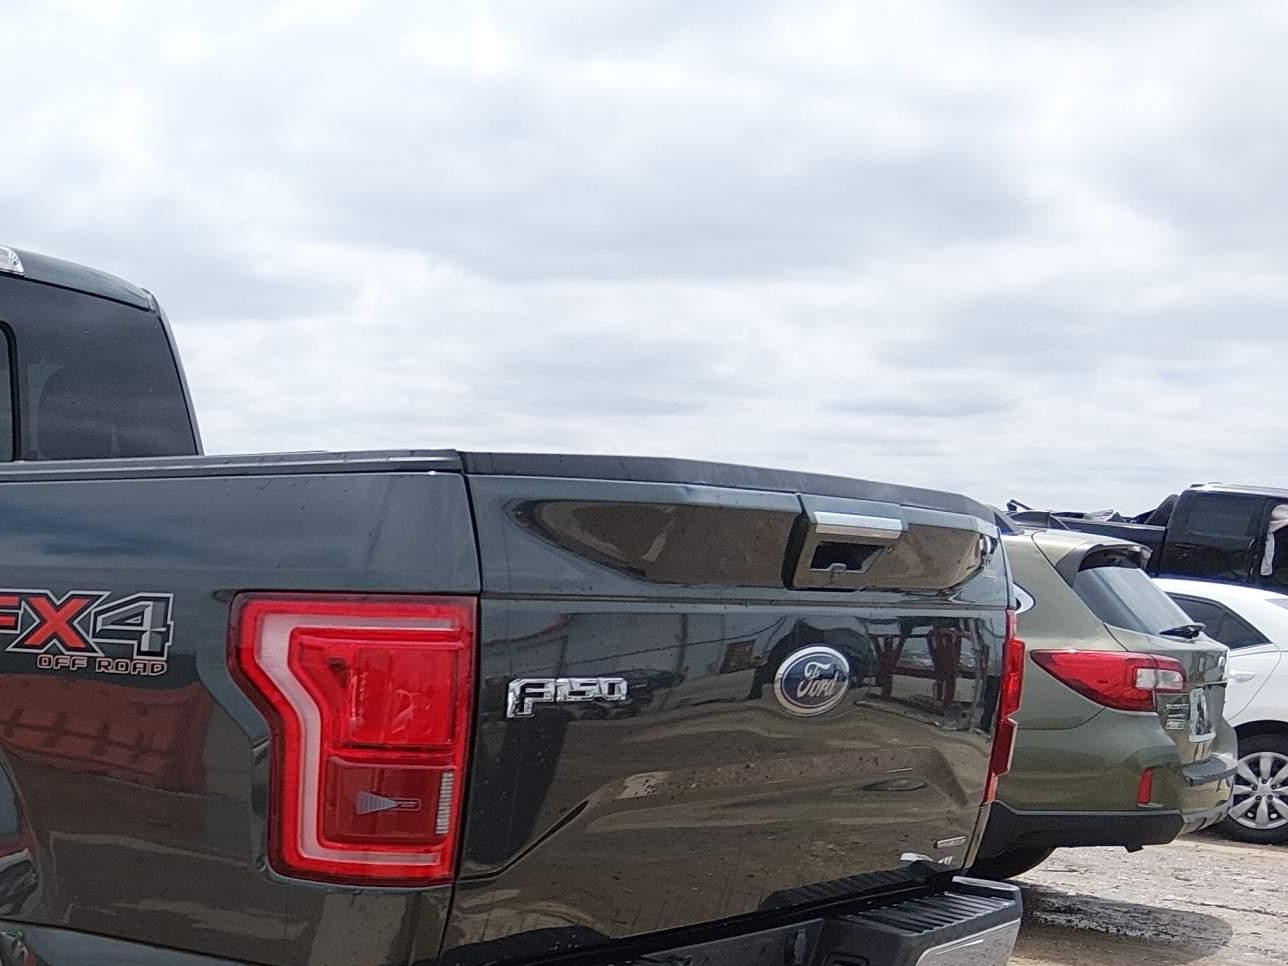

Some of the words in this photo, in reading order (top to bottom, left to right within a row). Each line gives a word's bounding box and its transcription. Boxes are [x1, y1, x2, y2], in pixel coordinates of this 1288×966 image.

[37, 653, 88, 671] OFF
[95, 657, 168, 676] ROAD
[796, 661, 839, 698] Ford
